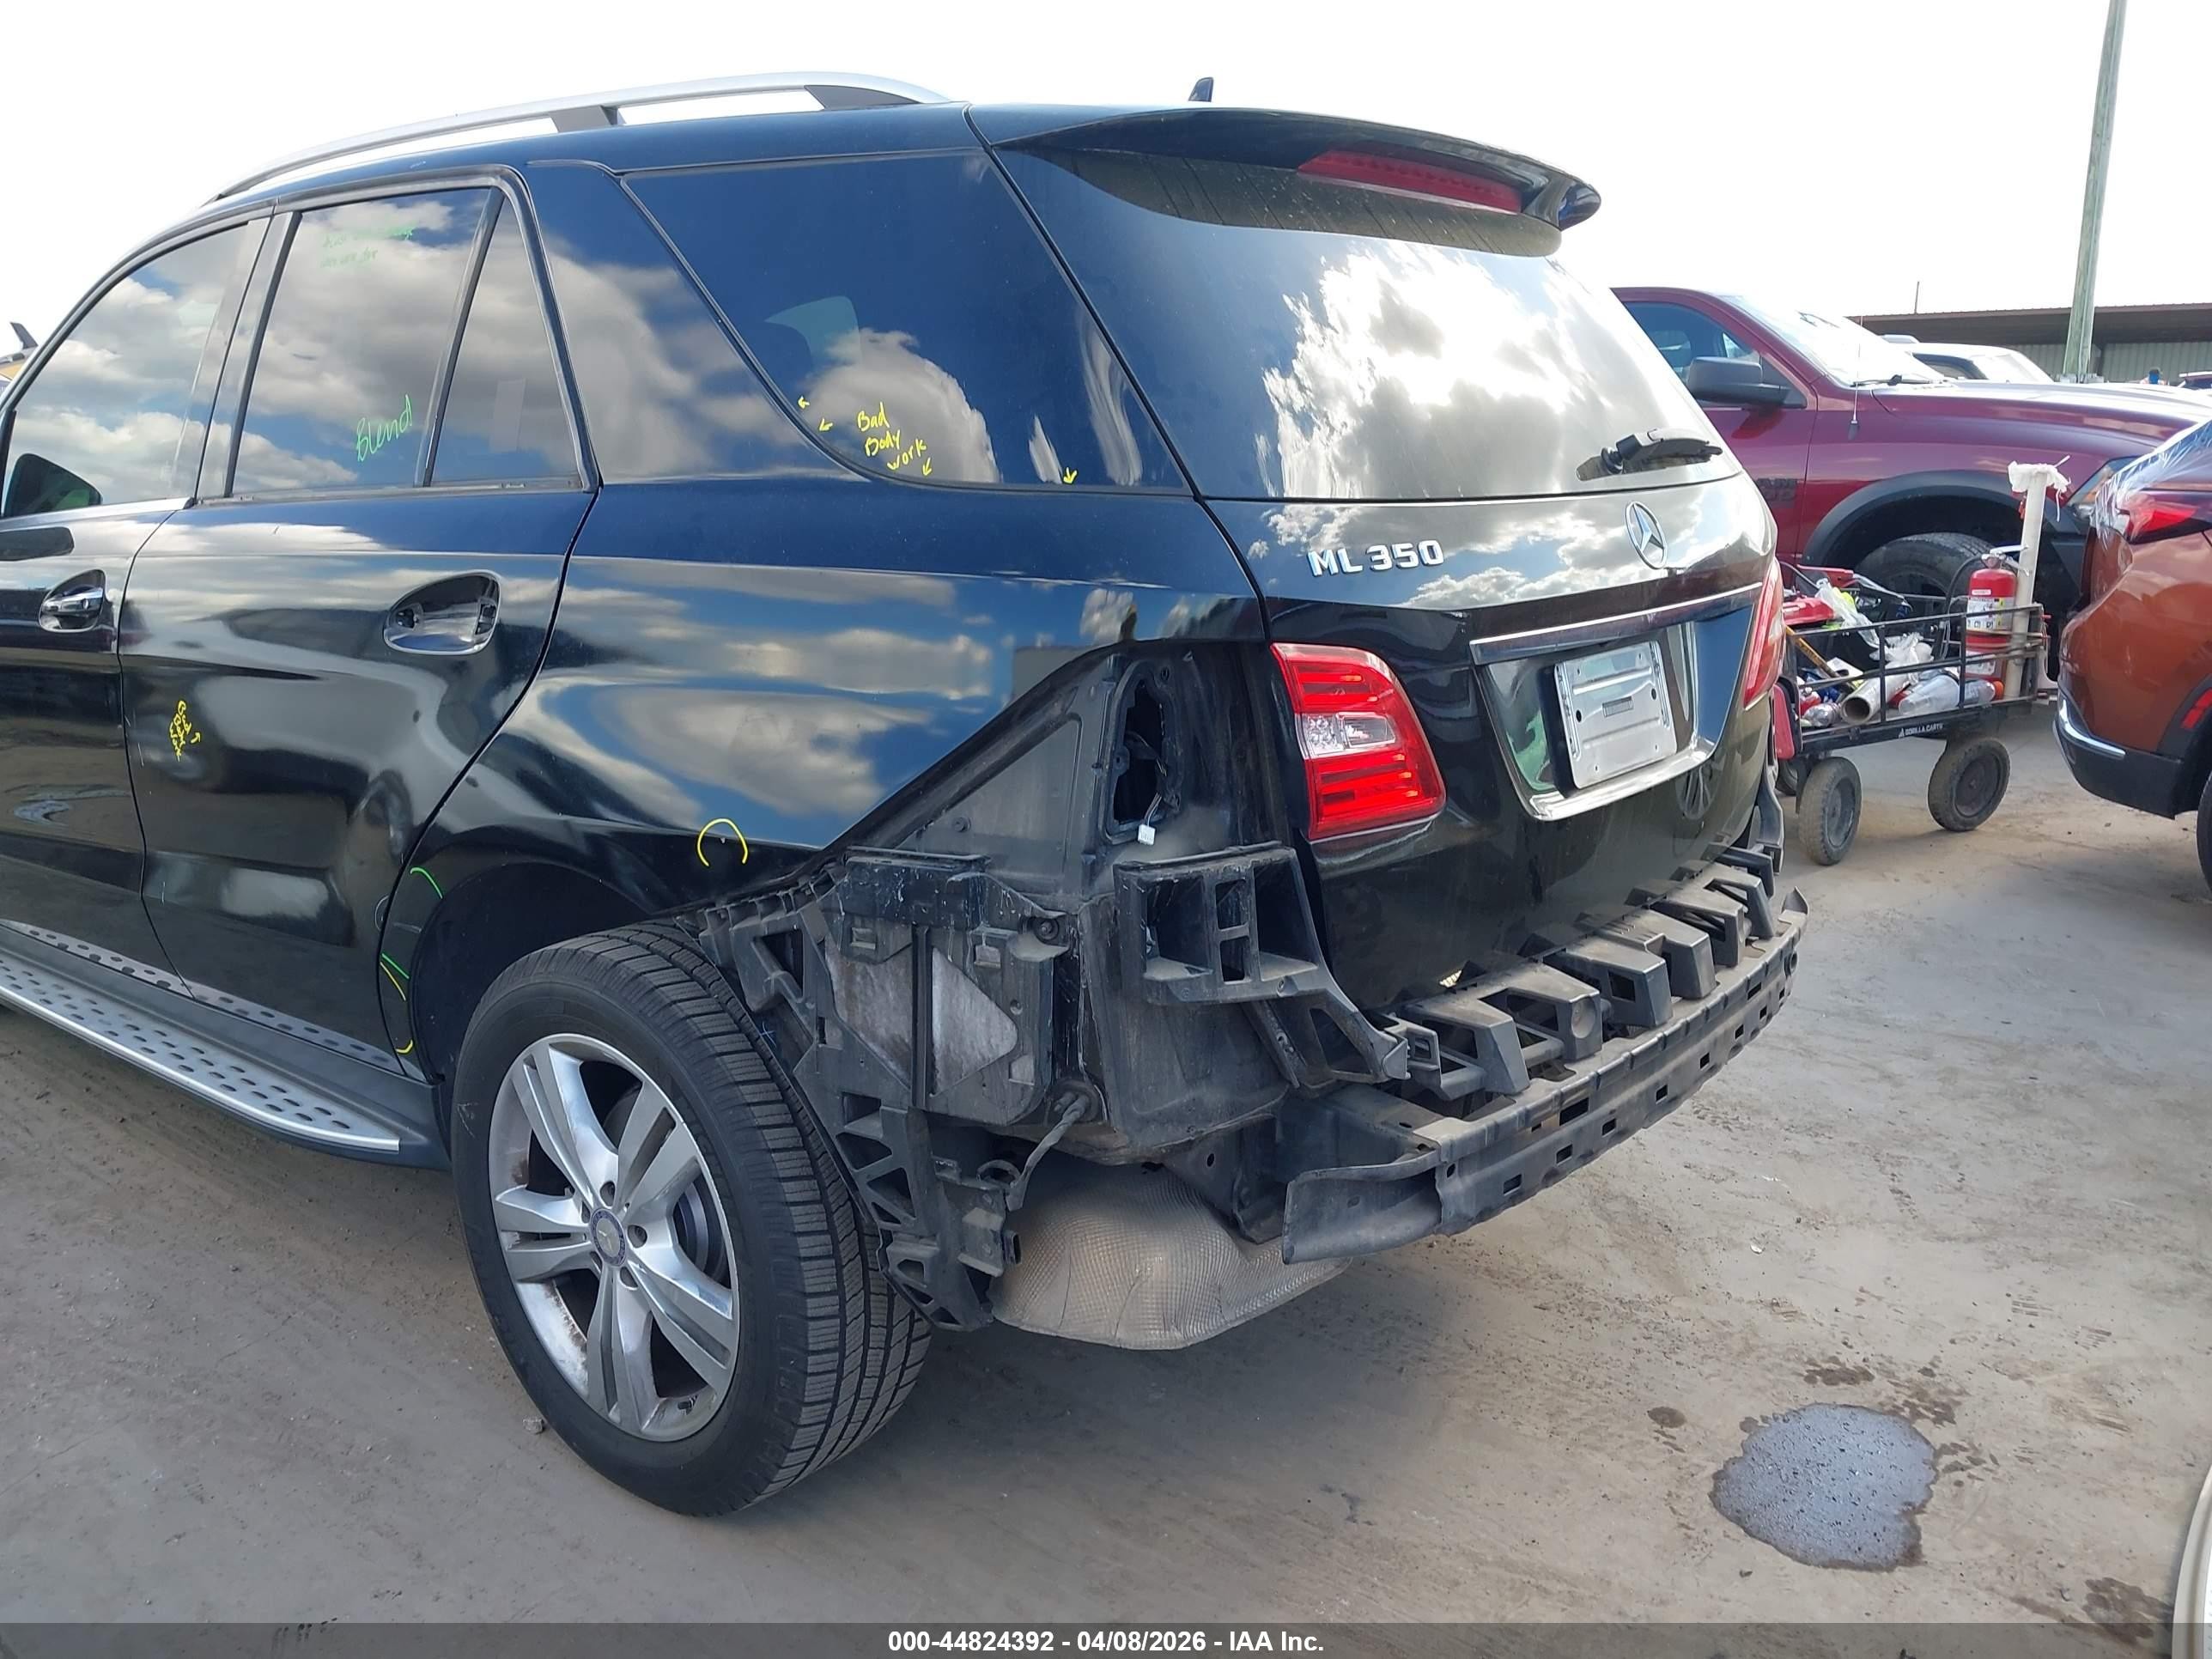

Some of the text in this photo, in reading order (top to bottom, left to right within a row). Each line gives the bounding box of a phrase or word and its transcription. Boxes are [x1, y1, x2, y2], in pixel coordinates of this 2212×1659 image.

[857, 401, 890, 432] Bad
[865, 429, 901, 457] Body
[1307, 539, 1445, 577] ML 350
